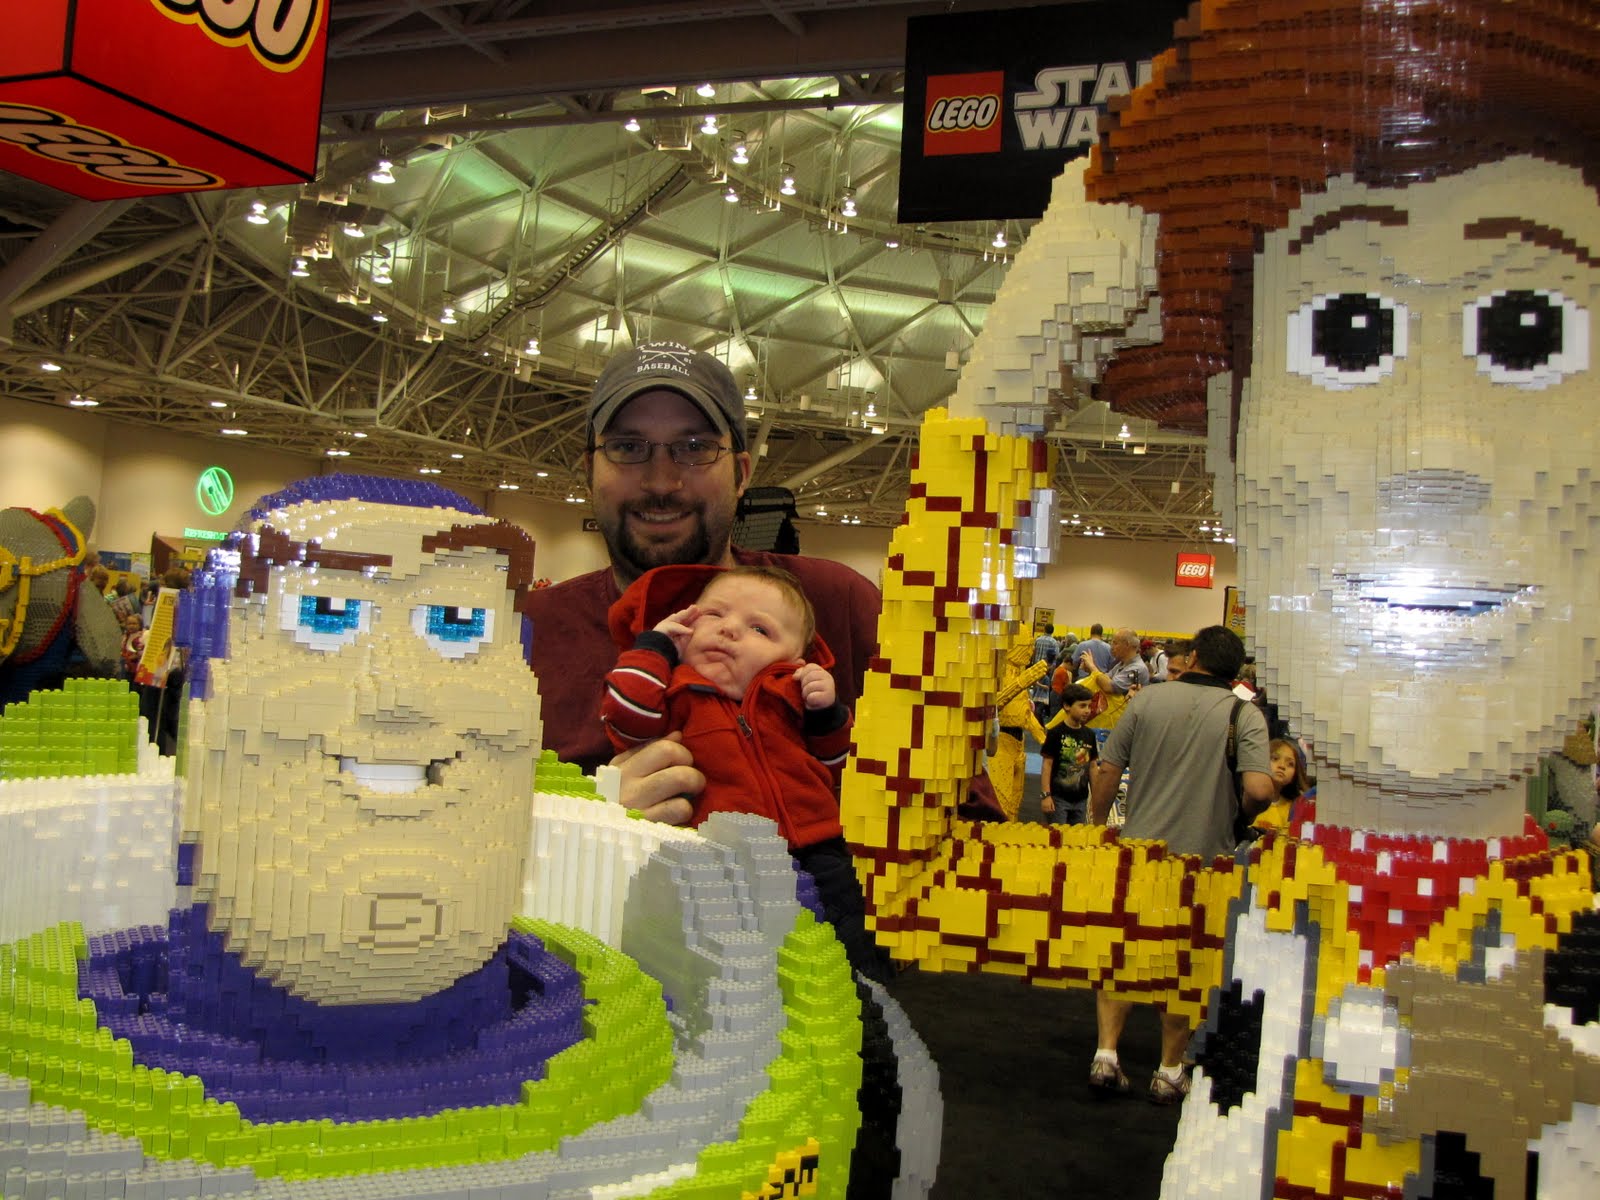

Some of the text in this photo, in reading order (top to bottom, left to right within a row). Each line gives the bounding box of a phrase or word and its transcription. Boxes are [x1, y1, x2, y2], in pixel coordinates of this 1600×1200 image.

[928, 97, 999, 132] LEGO
[636, 341, 698, 355] TWINS
[636, 362, 691, 377] BASEBALL
[1178, 563, 1208, 577] LEGO
